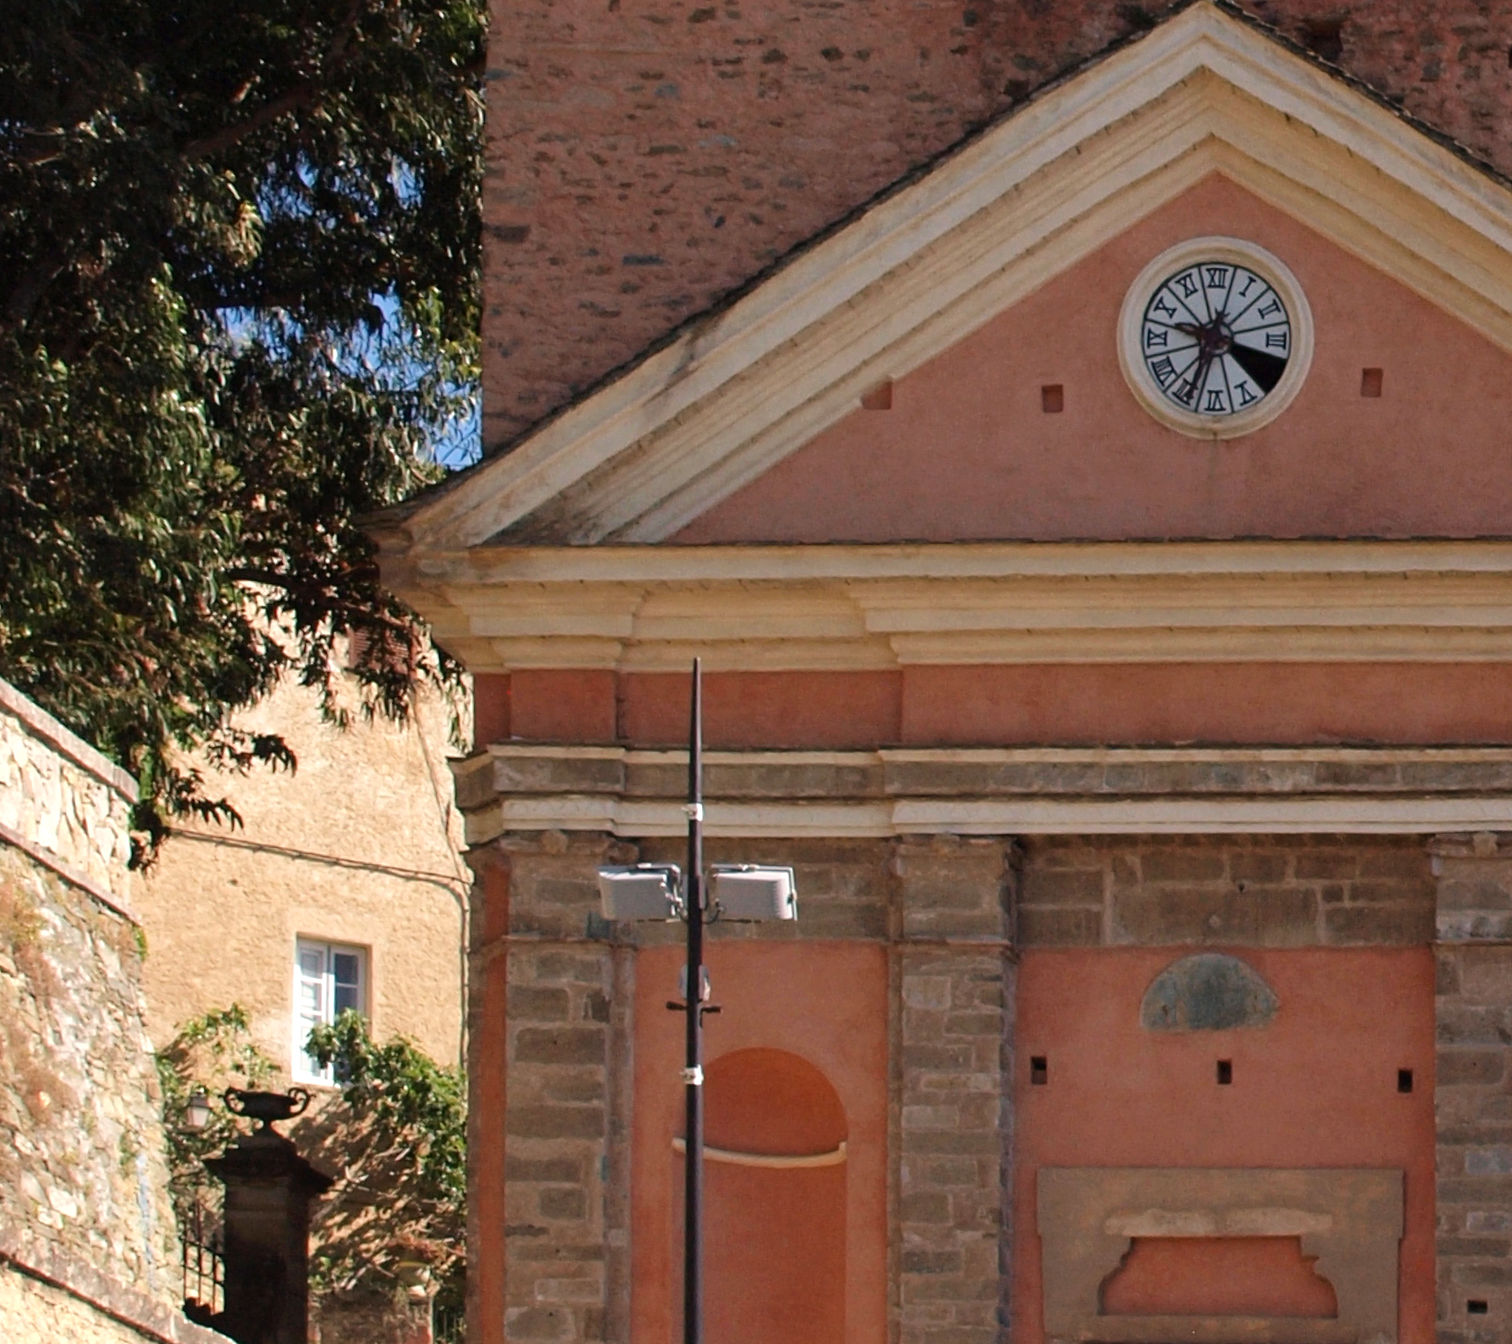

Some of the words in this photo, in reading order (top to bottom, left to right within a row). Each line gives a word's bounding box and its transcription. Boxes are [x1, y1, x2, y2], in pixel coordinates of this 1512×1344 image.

[1175, 272, 1199, 299] XI
[1206, 267, 1229, 289] XII
[1239, 276, 1257, 297] I
[1154, 296, 1177, 319] X
[1258, 299, 1282, 320] II
[1147, 328, 1168, 350] IX
[1266, 331, 1287, 350] III
[1204, 389, 1226, 411] VI
[1234, 380, 1258, 406] V
